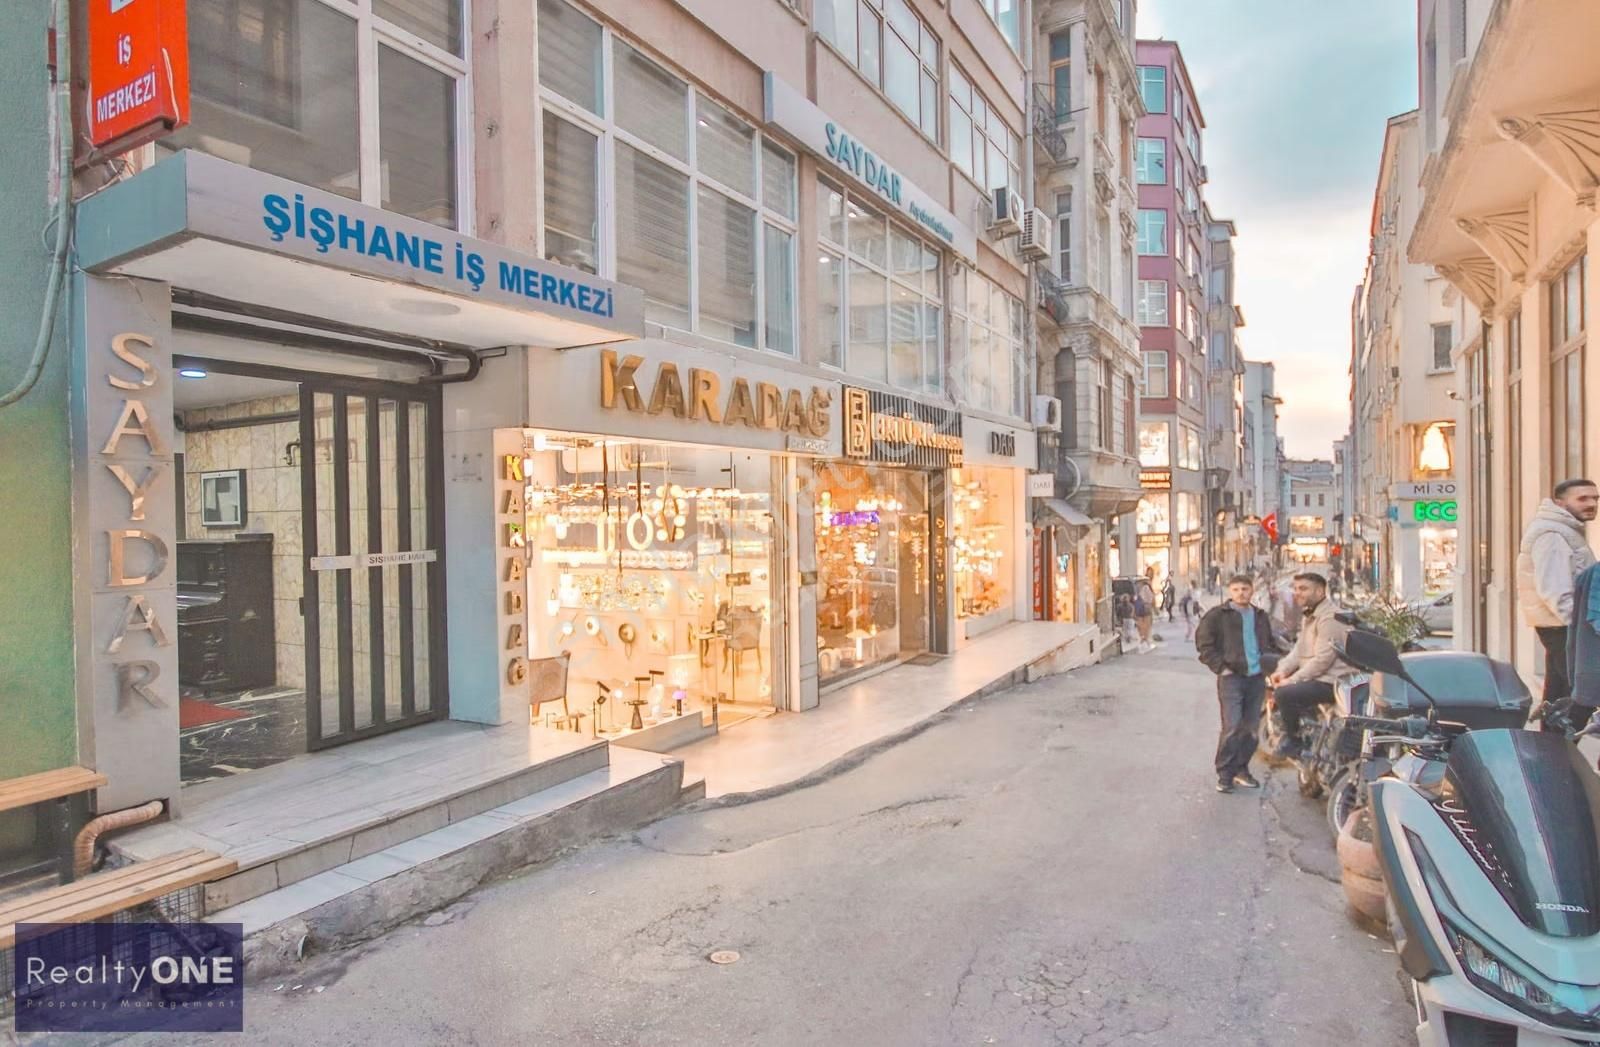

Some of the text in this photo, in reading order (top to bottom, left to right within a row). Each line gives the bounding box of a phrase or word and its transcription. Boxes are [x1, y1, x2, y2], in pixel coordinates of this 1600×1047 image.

[116, 34, 132, 65] İŞ
[96, 71, 156, 122] MERKEZİ
[825, 121, 903, 206] SAYDAR
[262, 192, 614, 318] ŞİŞHANE İŞ MERKEZİ
[600, 349, 832, 438] KARADAĞ
[101, 332, 169, 714] SAYDAR
[1536, 902, 1585, 913] HONDA
